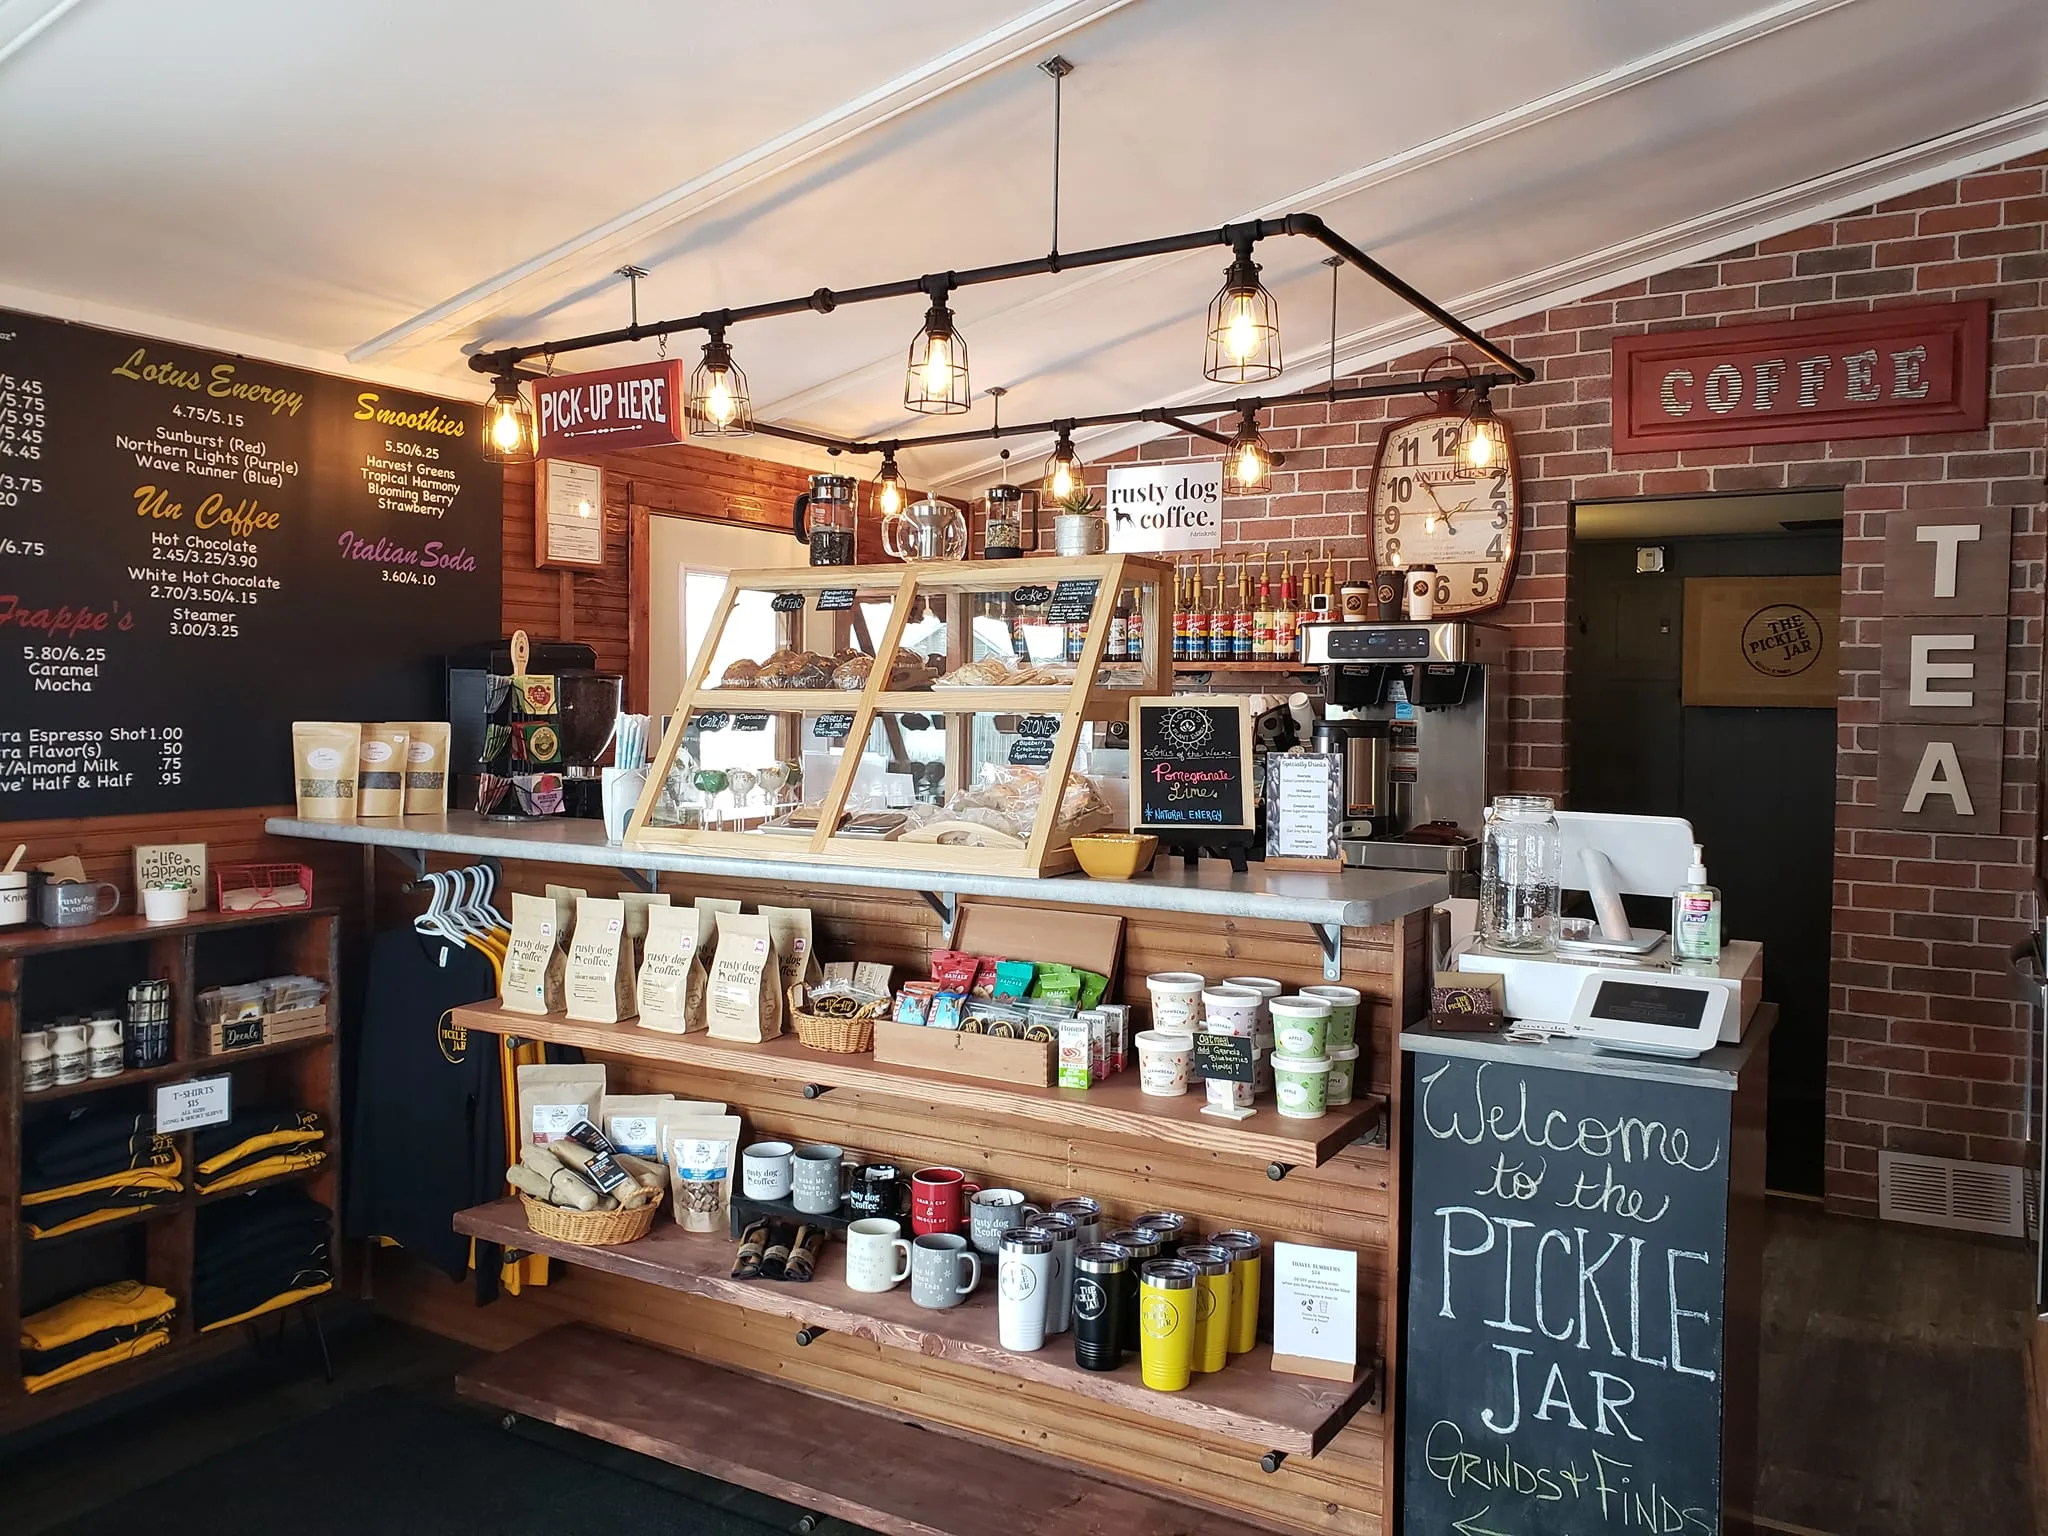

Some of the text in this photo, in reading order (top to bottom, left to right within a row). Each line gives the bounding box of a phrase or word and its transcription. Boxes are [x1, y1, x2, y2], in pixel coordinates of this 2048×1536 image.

[111, 348, 304, 417] Lotus Energy
[1660, 344, 1930, 416] COFFEE
[617, 378, 667, 424] HERE
[172, 404, 245, 428] 4.75/5.15
[354, 393, 465, 437] Smoothies
[156, 426, 266, 457] Sunburst (Red)
[385, 440, 440, 460] 5.50/6.25
[1398, 437, 1419, 466] 11
[116, 435, 299, 477] Northern Lights (Purple)
[135, 453, 283, 489] Wave Runner (Blue)
[366, 455, 456, 480] Harvest Greens
[360, 468, 461, 495] Tropical Harmony
[1111, 477, 1218, 506] rusty dog
[1387, 476, 1412, 503] 10
[368, 483, 454, 508] Blooming Berry
[133, 485, 281, 538] Un Coffee
[378, 497, 445, 519] Strawberry
[1140, 505, 1215, 529] coffee.
[1490, 500, 1508, 530] 3
[1384, 505, 1400, 534] 9
[151, 531, 257, 554] Hot Chocolate
[337, 531, 477, 572] Italian Soda
[1485, 533, 1503, 562] 4
[152, 547, 258, 568] 2.45/3.25/3.90
[127, 566, 281, 590] White Hot Chocolate
[381, 570, 436, 586] 3.60/4.10
[1471, 567, 1489, 597] 5
[150, 585, 258, 605] 2.70/3.50/4.15
[1435, 575, 1450, 604] 6
[173, 607, 237, 623] Steamer
[1768, 614, 1805, 634] THE
[169, 622, 239, 637] 3.00/3.25
[1749, 627, 1809, 654] PICKLE
[23, 645, 106, 661] 5.80/6.25
[1783, 640, 1813, 661] JAR
[28, 662, 99, 677] Caramel
[1902, 524, 1981, 816] TEA
[34, 678, 92, 692] Mocha
[1020, 719, 1058, 735] SCONES
[1172, 711, 1202, 723] LOTUS
[29, 727, 183, 745] Espresso Shot 1.00
[29, 742, 183, 759] Flavor(s) .50
[84, 757, 182, 773] Milk .75
[1151, 762, 1235, 784] Pomegranate
[32, 776, 72, 791] Half
[77, 775, 91, 788] &
[97, 772, 134, 788] Half
[158, 772, 182, 786] .95
[1168, 782, 1215, 801] Lime
[1188, 808, 1223, 822] ENERGY
[160, 852, 182, 865] Life
[141, 864, 201, 879] Happens
[513, 939, 549, 953] rusty dog
[575, 944, 613, 957] rusty dog
[647, 952, 687, 966] rusty dog
[718, 960, 761, 975] rusty dog
[785, 955, 802, 967] dog
[173, 1086, 215, 1100] T-SHIRTS
[1421, 1060, 1721, 1172] Welcome
[763, 1169, 778, 1177] dog
[864, 1191, 880, 1202] dog
[1474, 1151, 1670, 1223] to the
[993, 1219, 1009, 1229] dog
[1079, 1286, 1096, 1294] THE
[1434, 1206, 1716, 1382] PICKLE
[1481, 1343, 1644, 1442] JAR
